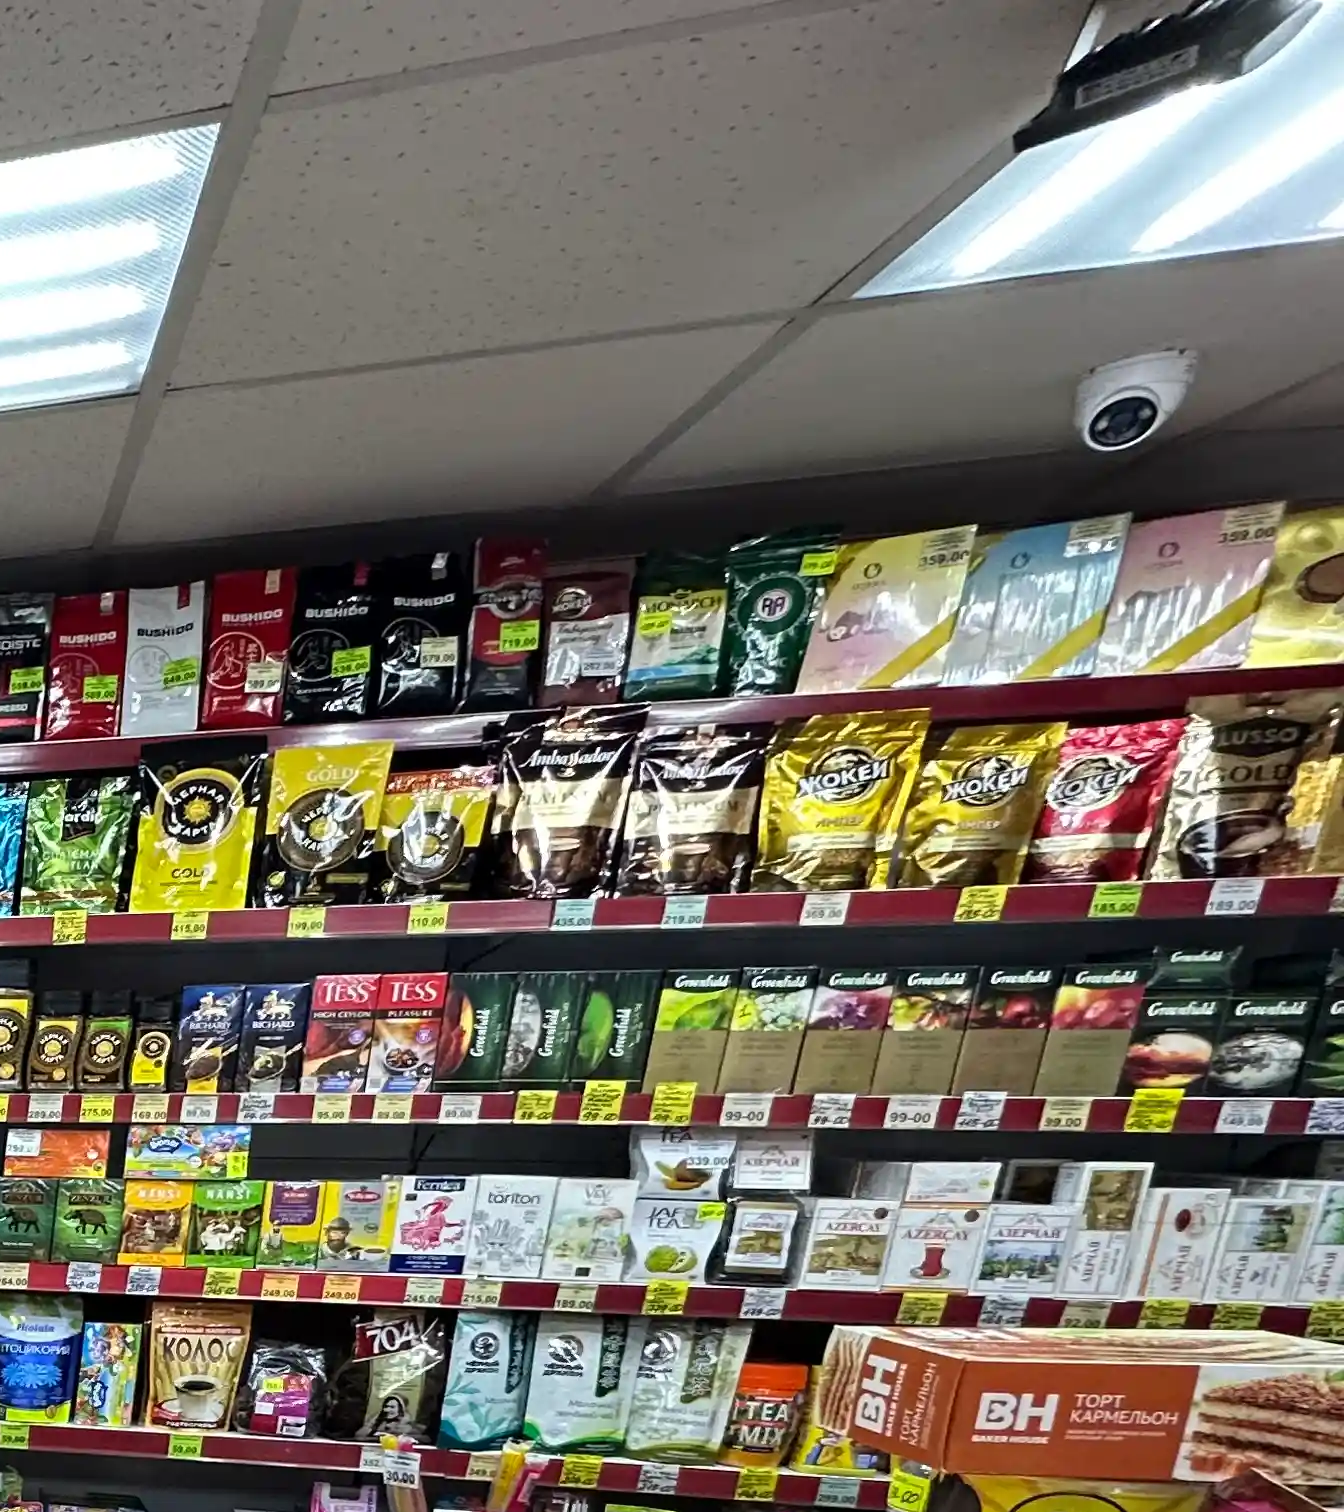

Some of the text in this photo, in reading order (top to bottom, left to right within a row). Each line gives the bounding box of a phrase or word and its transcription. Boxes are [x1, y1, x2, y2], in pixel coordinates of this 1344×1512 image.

[393, 593, 455, 609] BUSHIDO
[221, 609, 284, 624] BUSHIDO
[304, 604, 369, 620] BUSHIDO
[58, 631, 118, 645] BUSHIDO
[136, 622, 194, 638] BUSHIDO
[1217, 726, 1300, 747] LUSSO
[797, 759, 892, 794] ЖОКЕЙ
[943, 766, 1029, 802] ЖОКЕЙ
[389, 978, 439, 1002] TESS
[674, 975, 730, 990] Greenfield
[321, 980, 373, 1004] TESS
[1147, 1001, 1217, 1019] Greenfield
[1235, 1000, 1307, 1018] Greenfield
[724, 1110, 764, 1122] 99-00
[889, 1112, 931, 1123] 99-00
[855, 1356, 899, 1434] BH
[1075, 1394, 1126, 1408] ТОРТ
[745, 1401, 789, 1422] TEA
[974, 1393, 1060, 1433] BH
[1069, 1408, 1179, 1427] КАРМЕЛЬОН
[738, 1423, 785, 1445] MIX
